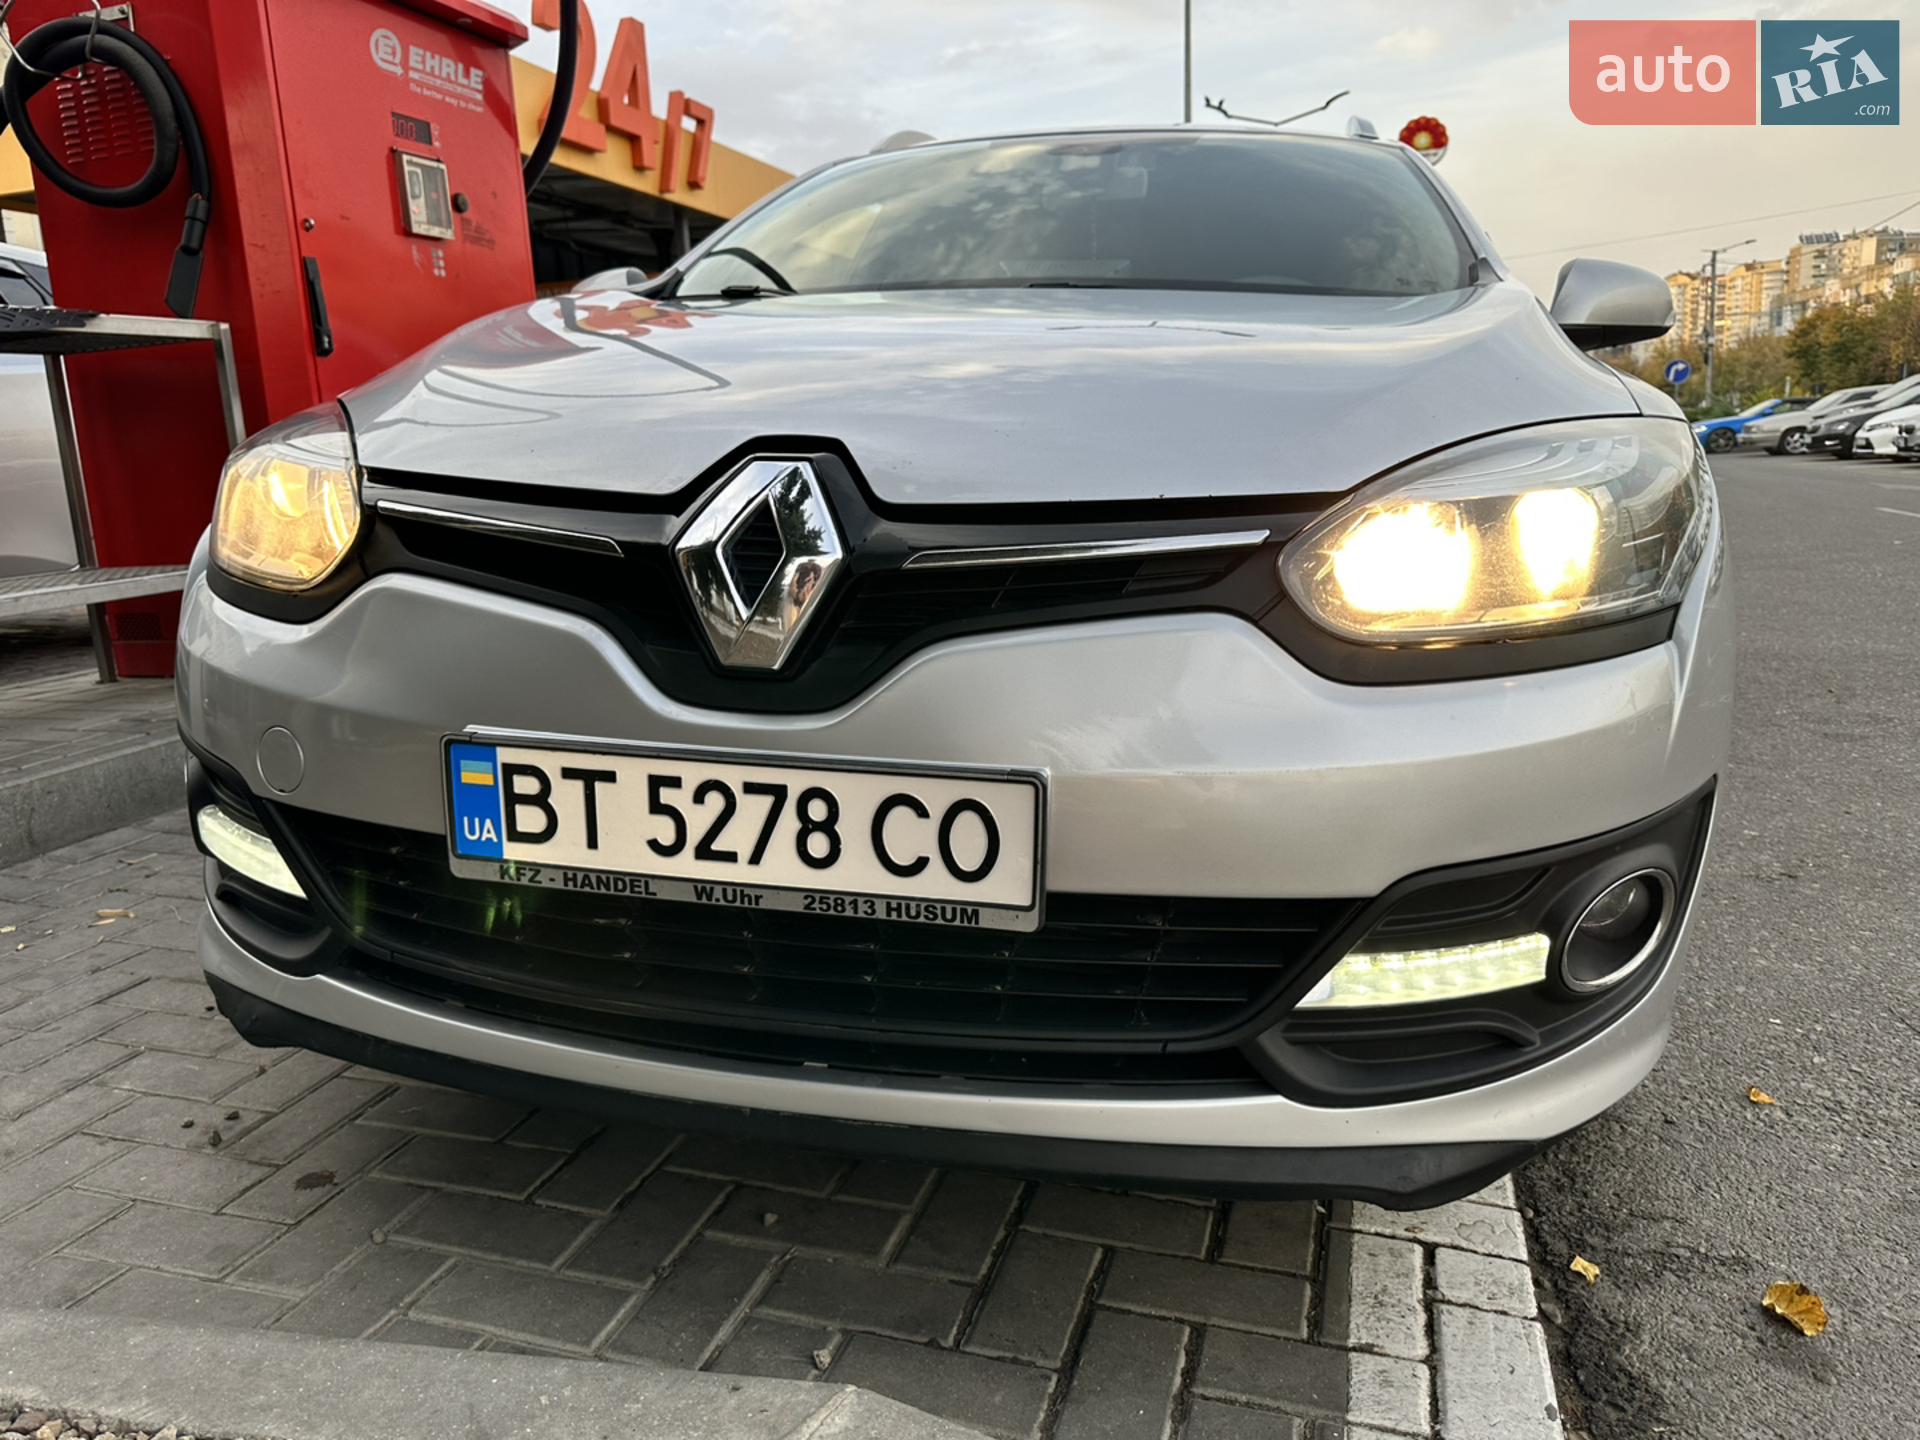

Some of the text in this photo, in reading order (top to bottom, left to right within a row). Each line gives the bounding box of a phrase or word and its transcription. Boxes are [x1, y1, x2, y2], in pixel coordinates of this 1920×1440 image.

[409, 44, 484, 91] EHRLE
[464, 816, 498, 843] UA
[501, 762, 1001, 883] BT 5278 CO
[499, 864, 543, 885] KFZ
[563, 871, 657, 897] HANDEL
[693, 884, 763, 907] W.Uhr
[802, 894, 877, 917] 25813
[886, 900, 980, 926] HUSUM
